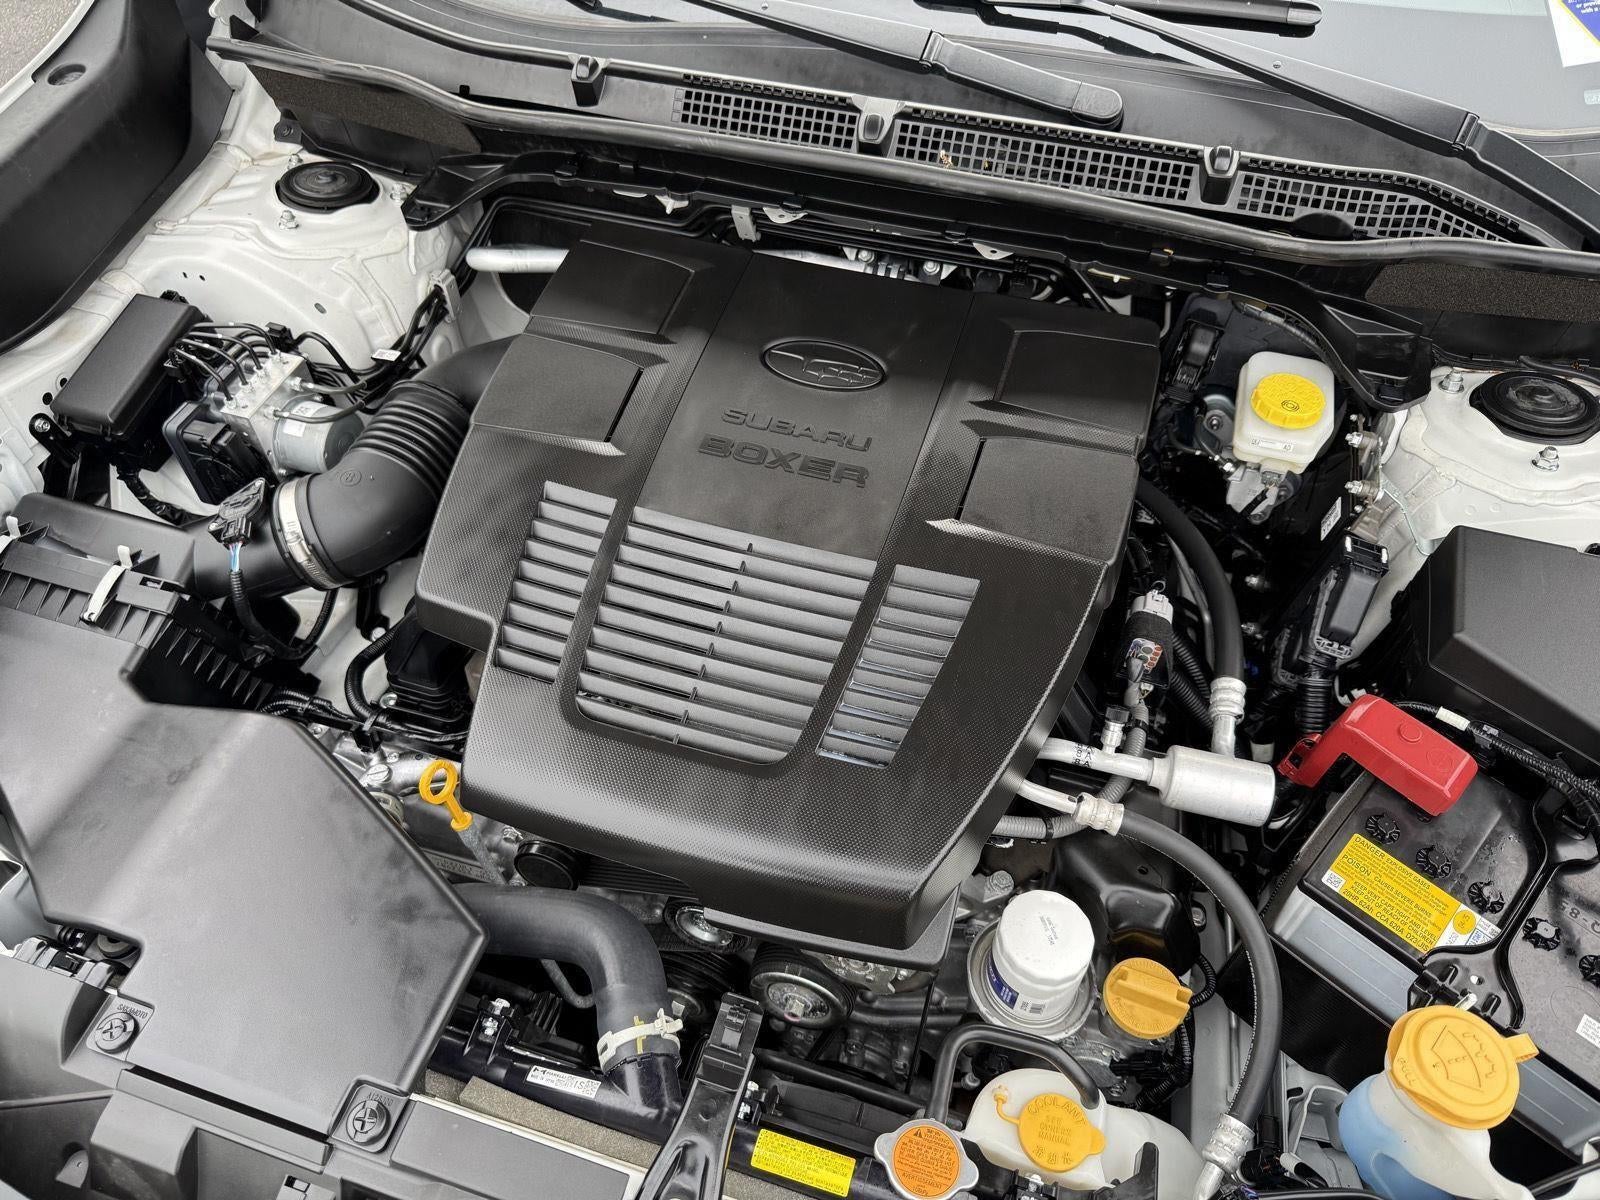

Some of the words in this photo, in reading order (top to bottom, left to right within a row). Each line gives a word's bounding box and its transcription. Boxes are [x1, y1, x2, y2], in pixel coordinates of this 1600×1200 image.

[721, 407, 873, 452] SUBARU
[698, 432, 870, 489] BOXER
[1341, 853, 1372, 877] POISON
[1373, 875, 1395, 894] CAUSES
[1394, 889, 1414, 906] SEVERE
[1413, 901, 1432, 918] BURNS
[1354, 836, 1386, 860] DANGER
[1385, 858, 1413, 878] EXPLOSIVE
[1413, 874, 1431, 890] GASES
[1342, 889, 1360, 903] 20HR
[1375, 911, 1389, 924] CCA
[1350, 886, 1364, 898] KEEP
[1363, 894, 1377, 905] OUT
[1382, 905, 1401, 921] REACH
[1407, 922, 1434, 946] CHILDREN
[1353, 881, 1368, 892] KEEP
[1367, 890, 1381, 901] VENT
[1380, 899, 1395, 911] CAPS
[1394, 907, 1410, 921] TIGHT
[1420, 925, 1438, 941] LEVEL
[1027, 1095, 1087, 1126] COOLANT
